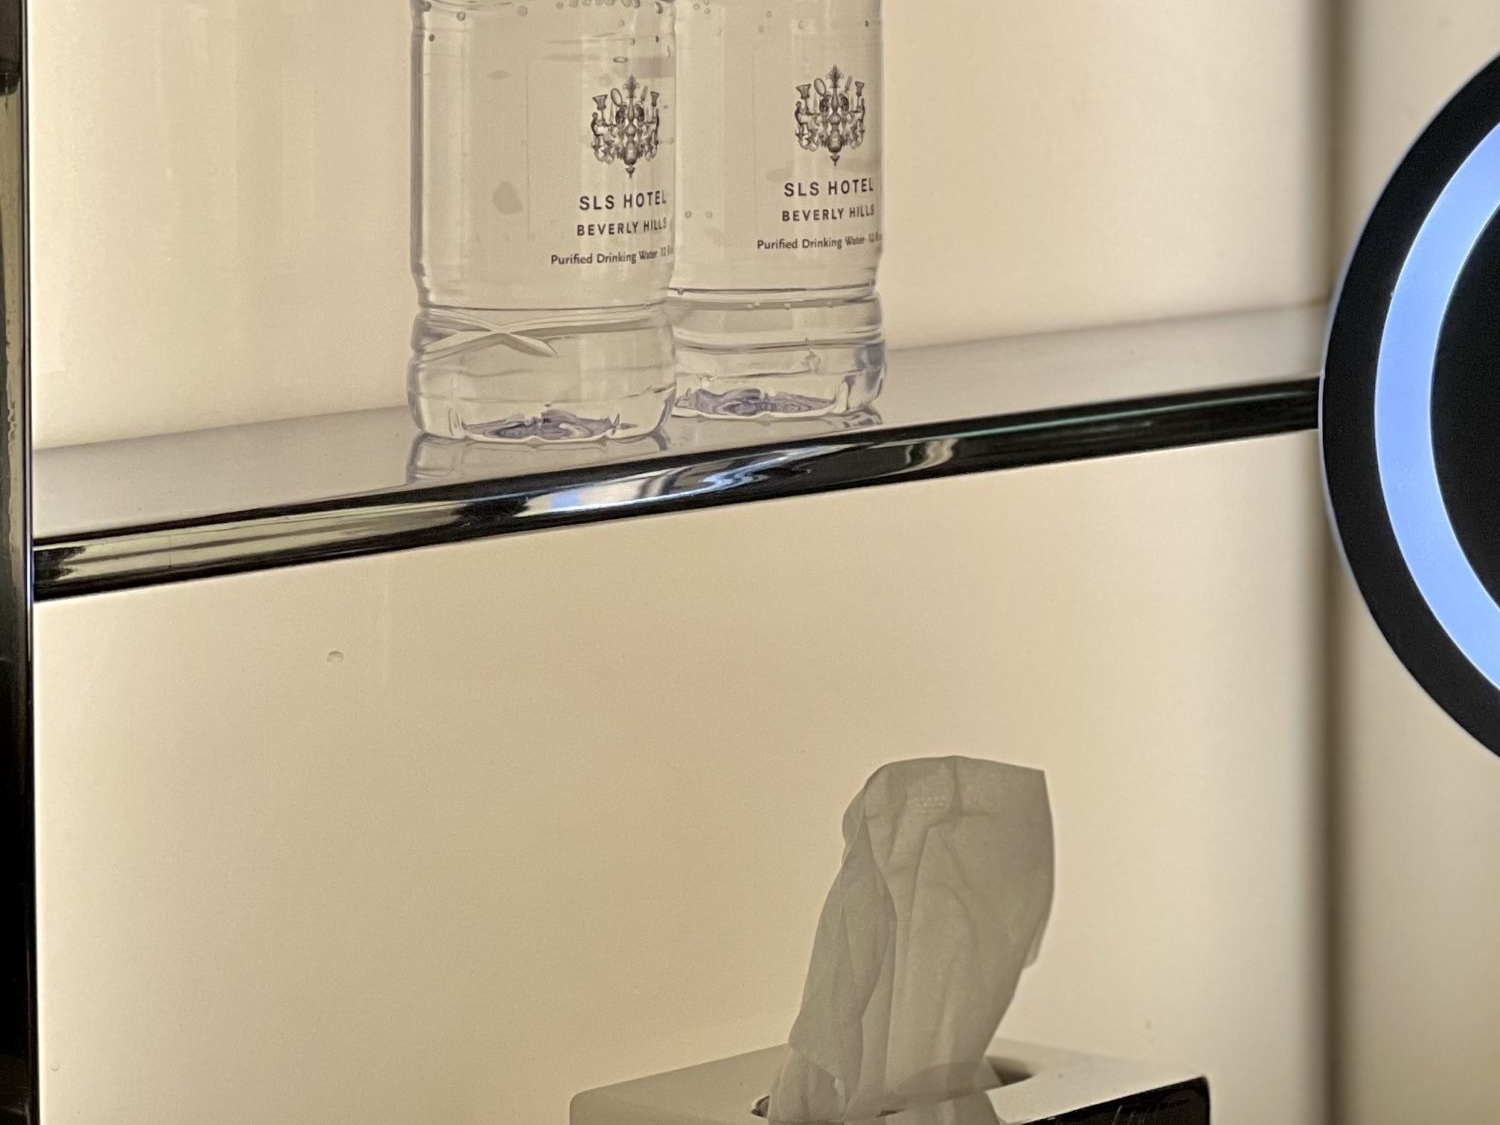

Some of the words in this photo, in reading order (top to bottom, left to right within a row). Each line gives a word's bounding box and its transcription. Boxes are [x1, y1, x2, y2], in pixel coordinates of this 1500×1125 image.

[784, 182, 819, 197] SLS
[828, 178, 874, 195] HOTEL
[579, 195, 615, 211] SLS
[623, 190, 667, 209] HOTEL
[782, 208, 844, 222] BEVERLY
[849, 204, 875, 218] HILLS
[577, 221, 639, 236] BEVERLY
[643, 217, 667, 232] HILLS
[757, 238, 798, 249] Purified
[802, 237, 842, 249] Drinking
[845, 235, 865, 246] Water
[551, 253, 593, 265] Purified
[596, 252, 637, 264] Drinking
[639, 250, 658, 260] Water
